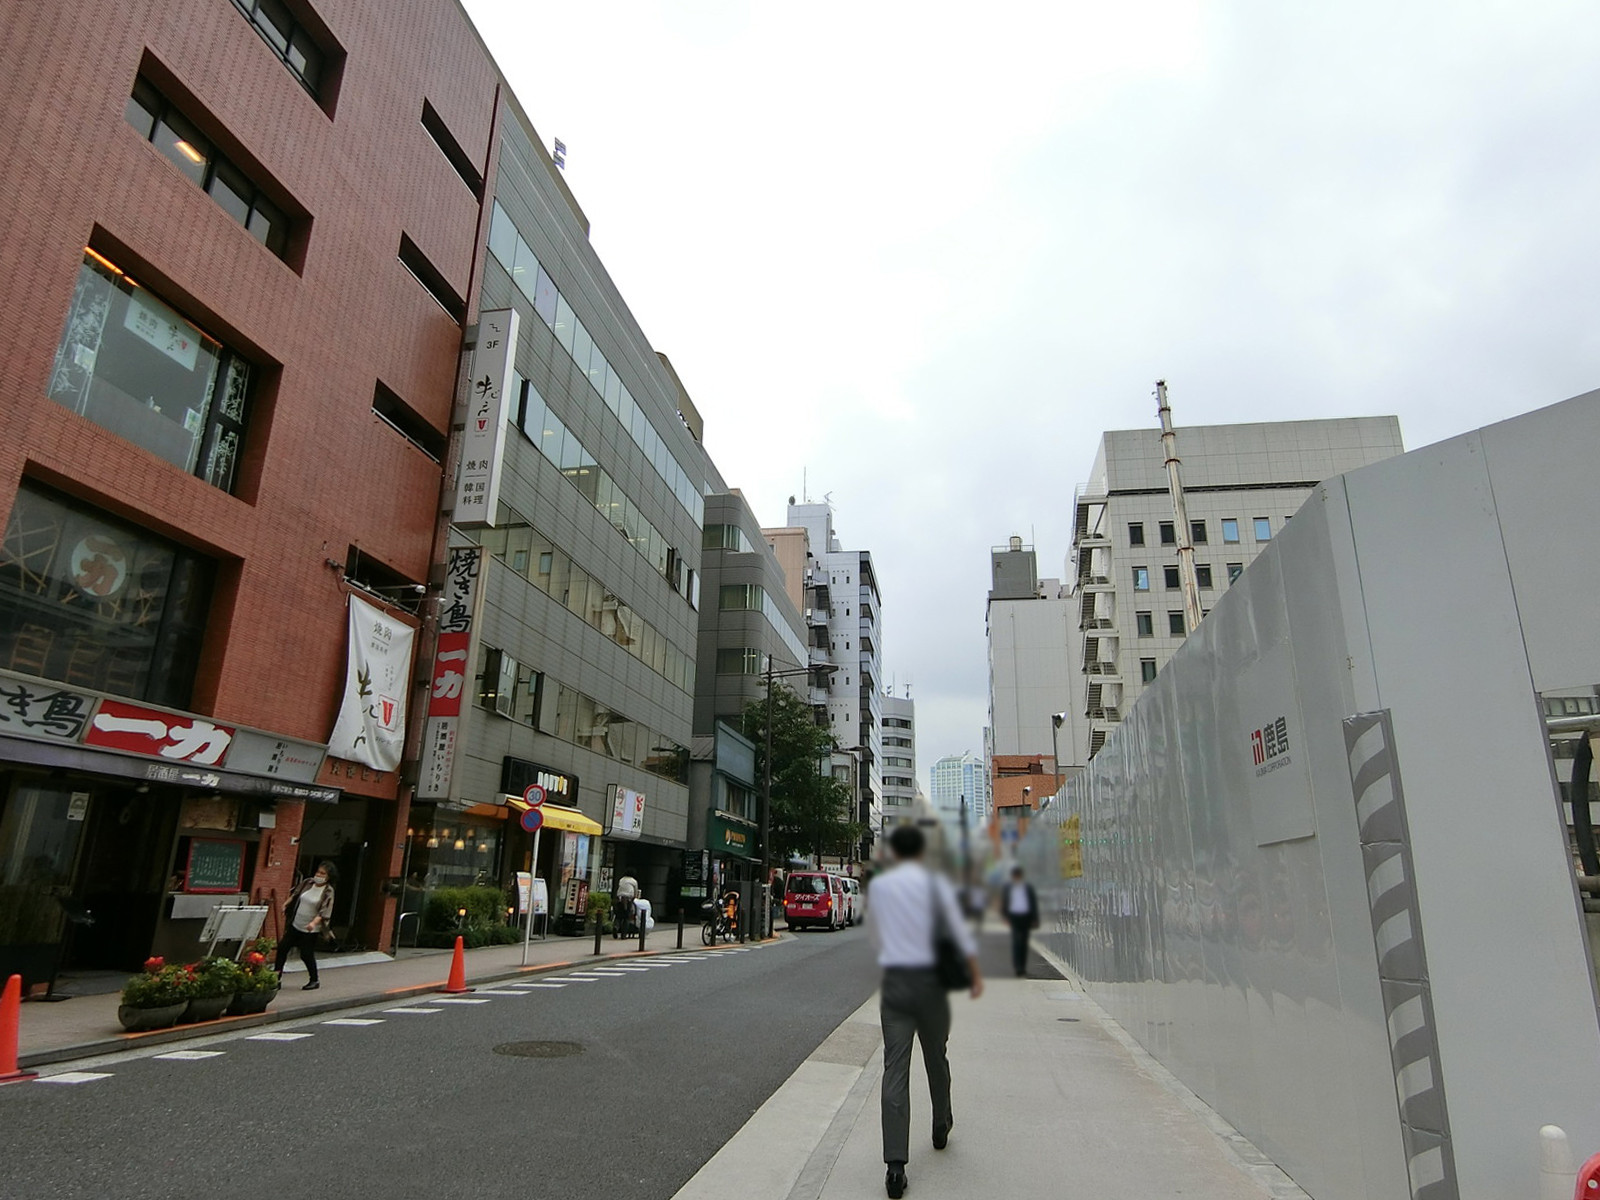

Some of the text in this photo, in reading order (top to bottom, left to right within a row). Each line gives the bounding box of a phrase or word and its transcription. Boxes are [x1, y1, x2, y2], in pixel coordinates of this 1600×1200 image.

[486, 340, 500, 349] 3F
[465, 459, 489, 471] 焼肉
[462, 495, 484, 506] 料理
[441, 548, 480, 633] 焼き鳥
[432, 648, 467, 700] 一力
[93, 713, 232, 765] 一力
[1264, 716, 1290, 759] 鹿島
[145, 764, 180, 781] 居酒屋
[181, 773, 221, 788] 一力
[528, 790, 542, 801] 30
[794, 893, 821, 901] ダイオーズ
